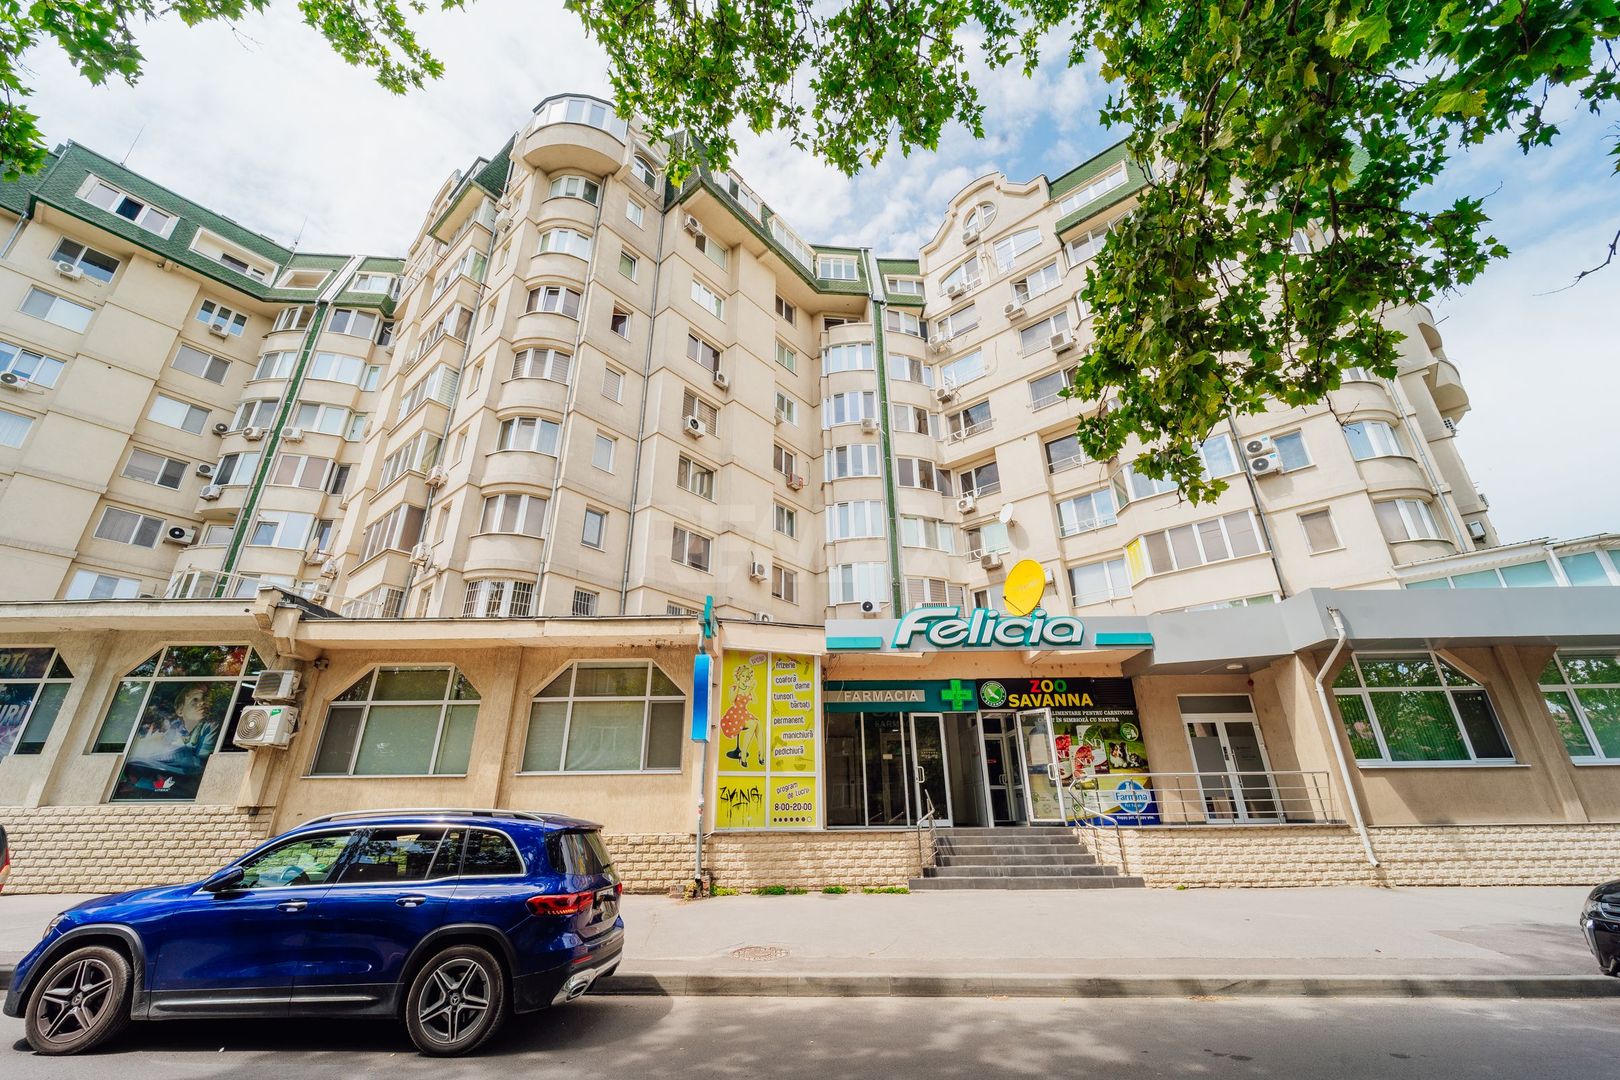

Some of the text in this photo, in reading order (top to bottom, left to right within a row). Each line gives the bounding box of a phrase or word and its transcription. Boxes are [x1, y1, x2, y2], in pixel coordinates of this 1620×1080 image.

[894, 605, 1084, 647] Felicia
[776, 661, 796, 669] frizerie
[795, 682, 810, 690] dame
[1030, 680, 1067, 693] ZOO
[844, 690, 919, 702] FARMACIA
[1008, 693, 1094, 707] SAVANNA
[773, 717, 804, 725] permanent
[782, 730, 814, 739] manichiură
[774, 745, 804, 756] pedichiură
[776, 782, 798, 794] program
[1115, 792, 1148, 801] Farmna
